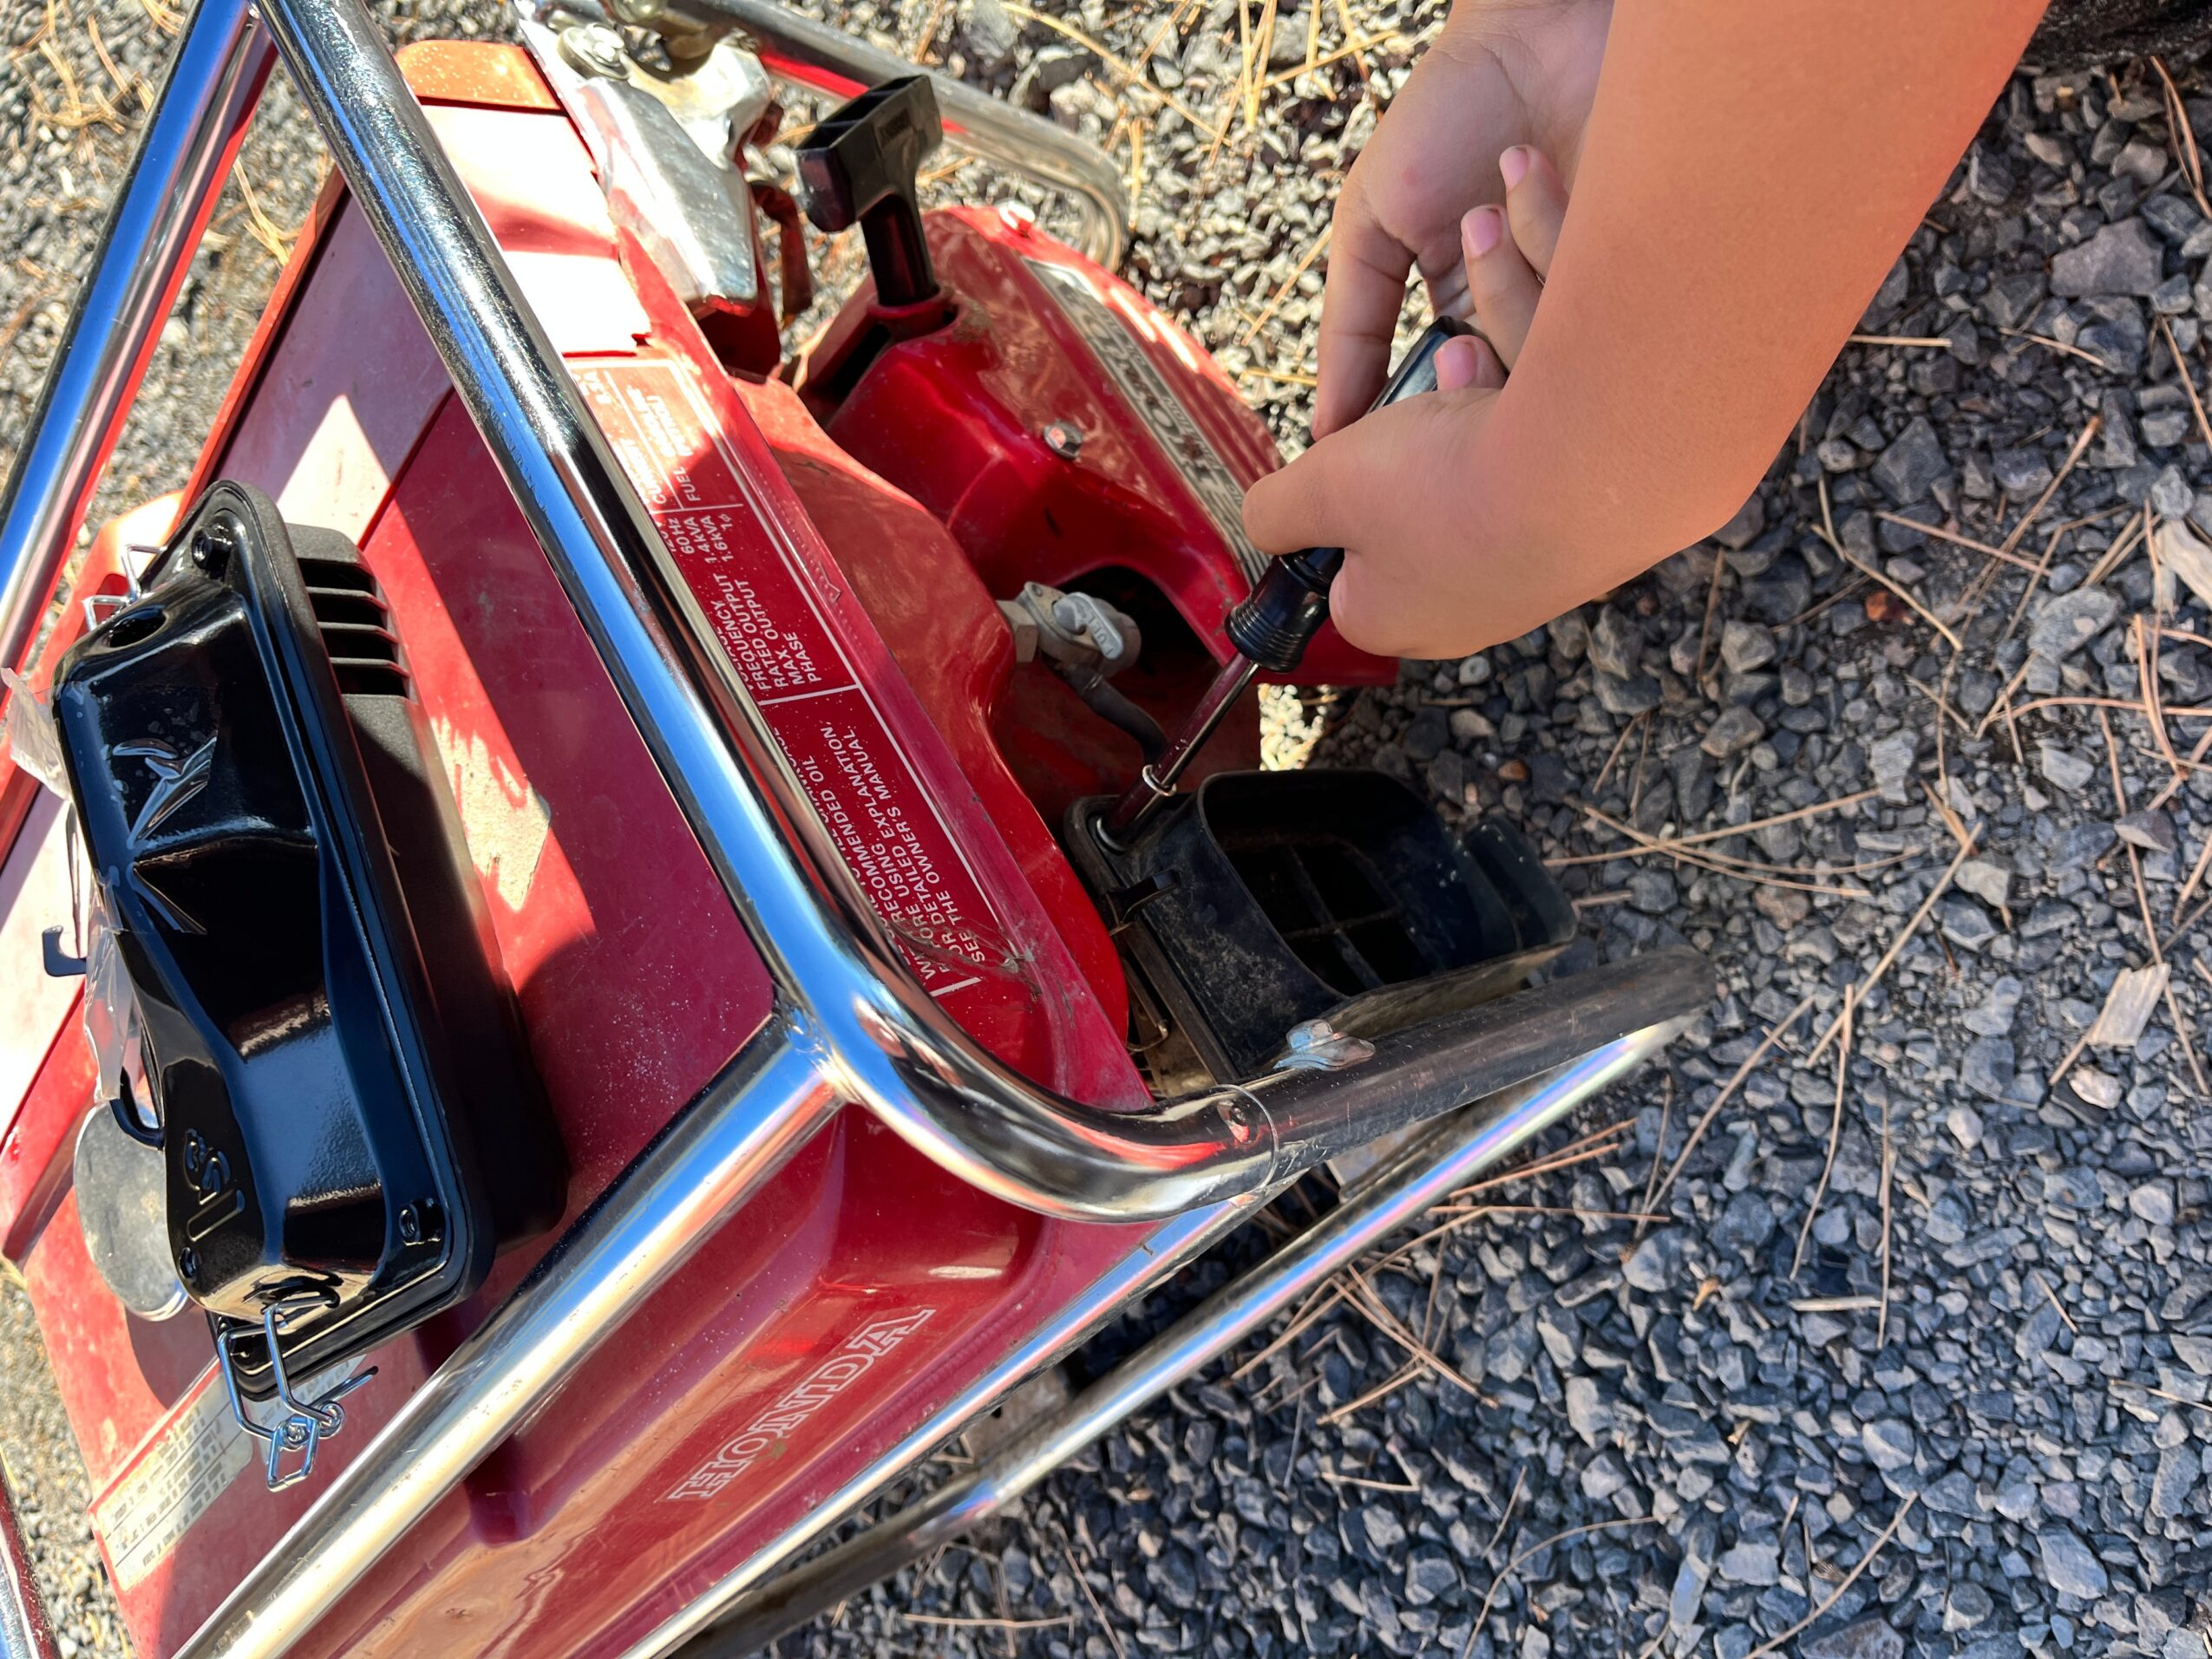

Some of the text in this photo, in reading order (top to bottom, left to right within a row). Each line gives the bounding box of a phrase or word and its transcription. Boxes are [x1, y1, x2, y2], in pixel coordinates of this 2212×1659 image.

[673, 467, 701, 501] FUEL
[712, 572, 758, 634] OUTPUT
[734, 578, 780, 639] OUTPUT
[710, 600, 772, 689] FREQUENCY
[751, 638, 789, 687] RATED
[775, 645, 805, 683] MAX.
[783, 630, 822, 682] PHASE
[802, 756, 824, 781] OIL
[820, 722, 895, 838] EXPLANATION,
[820, 790, 905, 922] RECOMMENDED
[841, 727, 985, 962] SEE THE OWNER'S MANUAL.
[870, 839, 910, 895] USING.
[891, 846, 945, 924] DETAILED
[668, 1309, 936, 1499] HONDA
